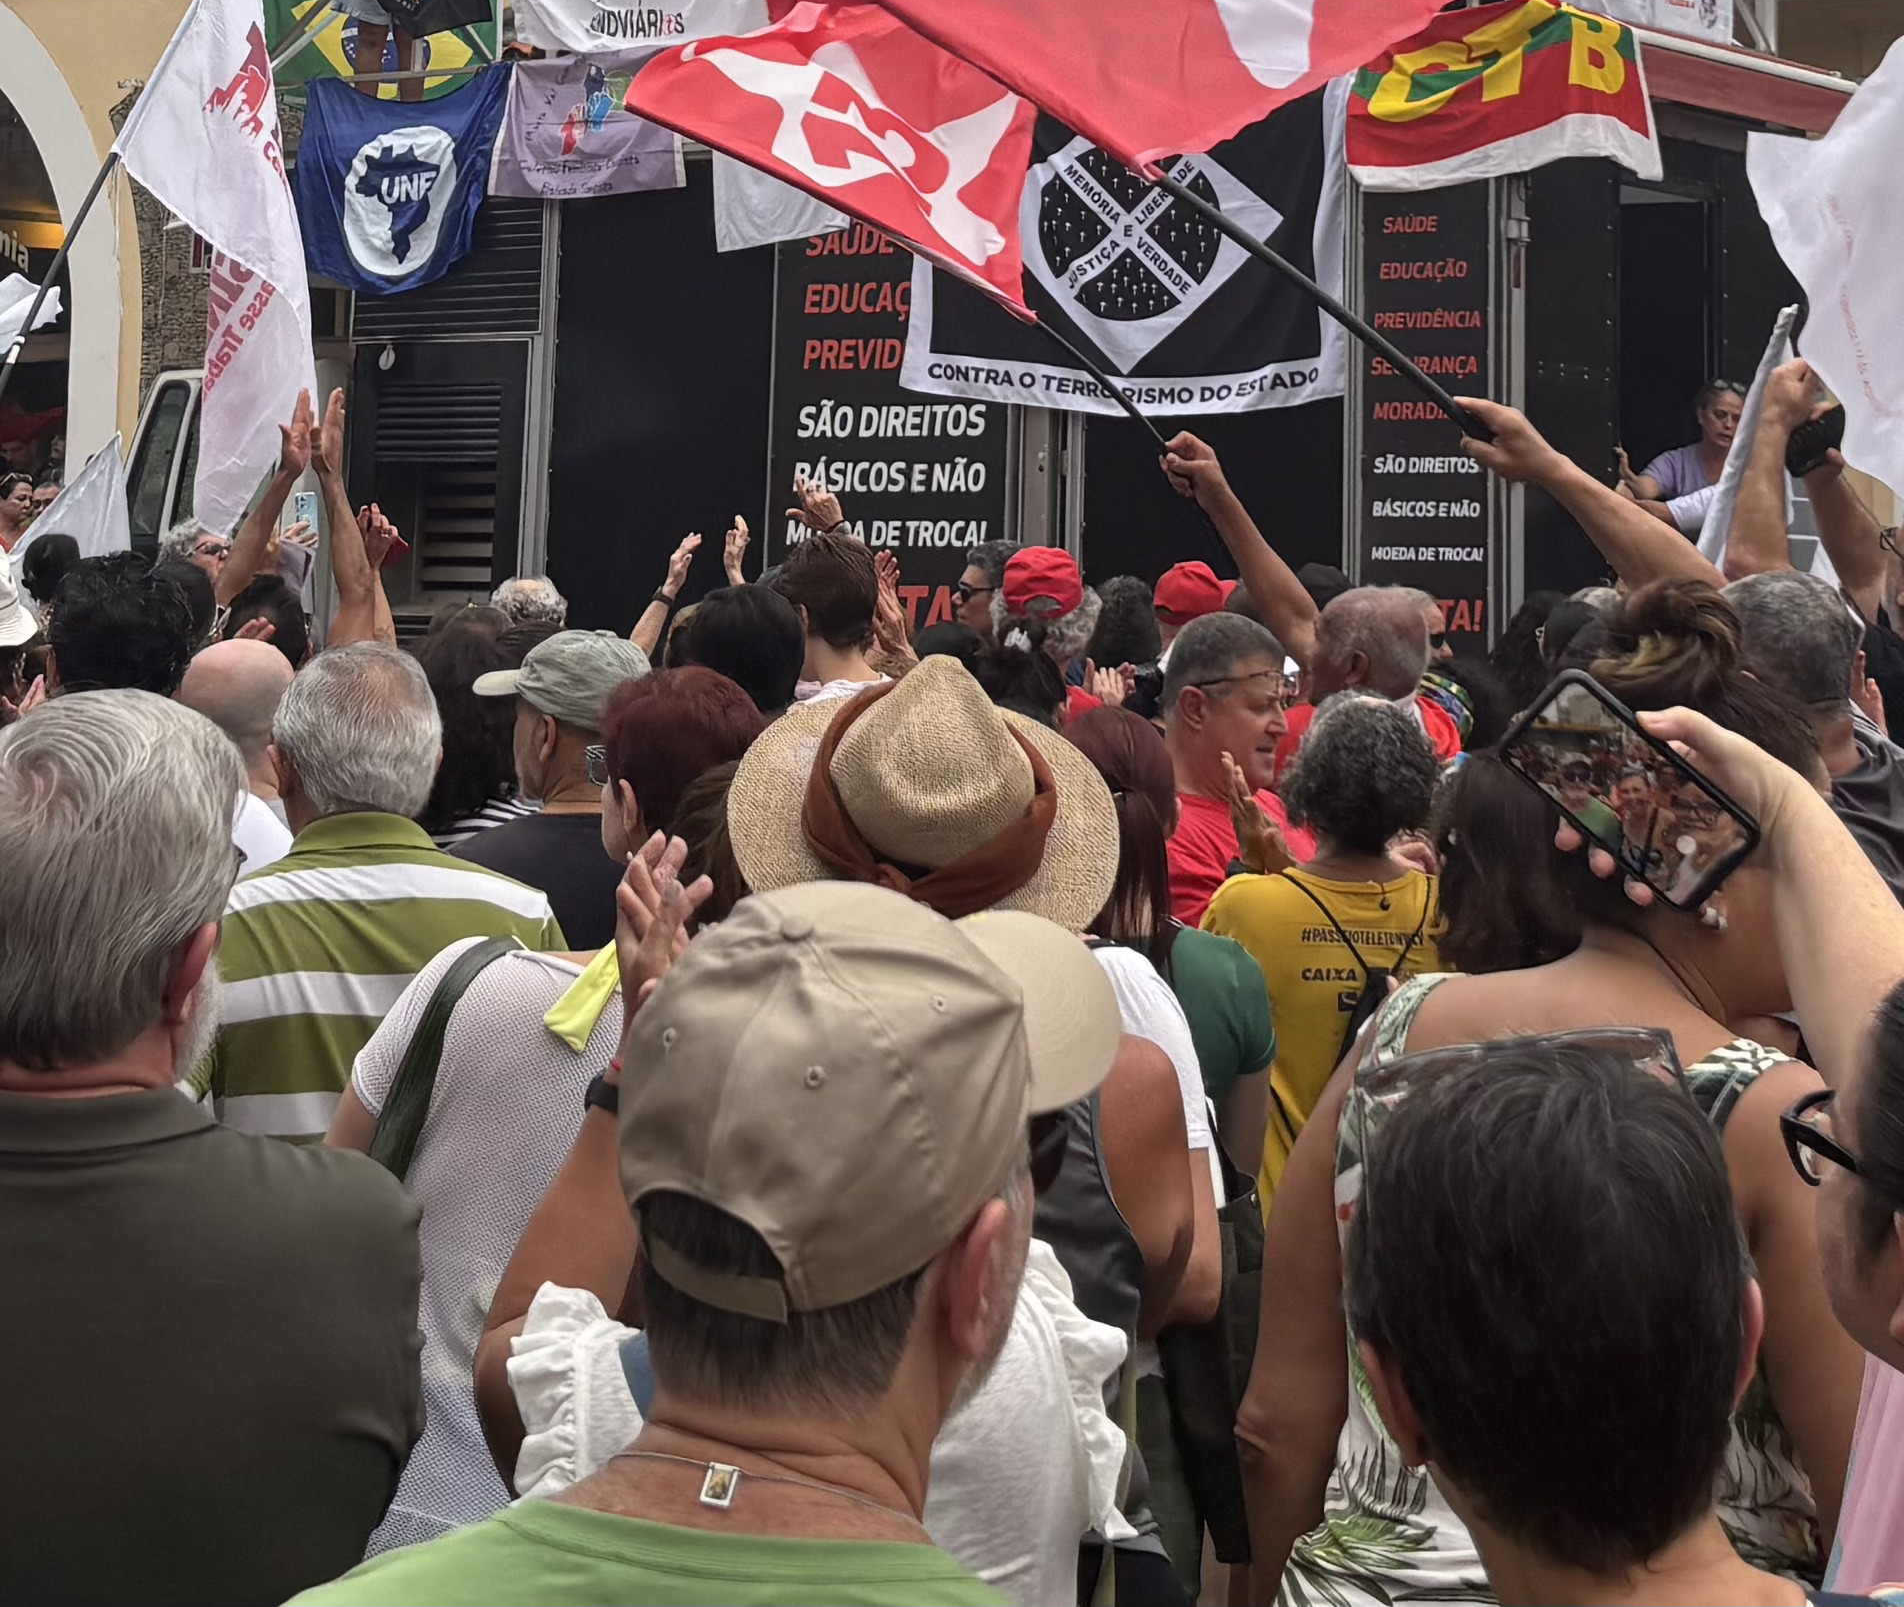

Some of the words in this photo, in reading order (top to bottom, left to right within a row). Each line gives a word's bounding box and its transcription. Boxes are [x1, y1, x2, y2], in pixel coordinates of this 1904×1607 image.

[800, 70, 949, 218] 13
[1063, 164, 1121, 225] MEMÓRIA
[1135, 160, 1195, 225] LIBERDE
[1123, 225, 1133, 237] E
[1382, 214, 1438, 234] SAÚDE
[1068, 239, 1120, 289] JUSTIÇA
[1136, 237, 1192, 295] VERDADE
[1379, 258, 1468, 282] EDUCAÇÃO
[804, 281, 910, 321] EDUCAÇ
[1374, 307, 1481, 330] PREVIDÊNCIA
[803, 338, 906, 370] PREVID
[1371, 354, 1478, 380] SERANÇA
[927, 362, 1014, 388] CONTRA
[1018, 371, 1036, 389] O
[1199, 383, 1232, 403] DO
[1235, 366, 1320, 398] ESTADO
[797, 399, 853, 438] SÃO
[858, 404, 986, 438] DIREITOS
[792, 456, 905, 493] BÁSICOS
[910, 463, 928, 494] E
[931, 456, 986, 493] NÃO
[1373, 453, 1405, 474] SÃO
[1408, 456, 1480, 474] DIREITOS
[1372, 498, 1436, 518] BÁSICOS
[1438, 502, 1449, 517] E
[1450, 498, 1480, 518] NÃO
[871, 519, 902, 547] DE
[904, 519, 987, 547] TROCA!
[1371, 546, 1417, 561] MOEDA
[1418, 547, 1436, 561] DE
[1437, 546, 1484, 562] TROCA!
[1301, 967, 1357, 982] CAIXA
